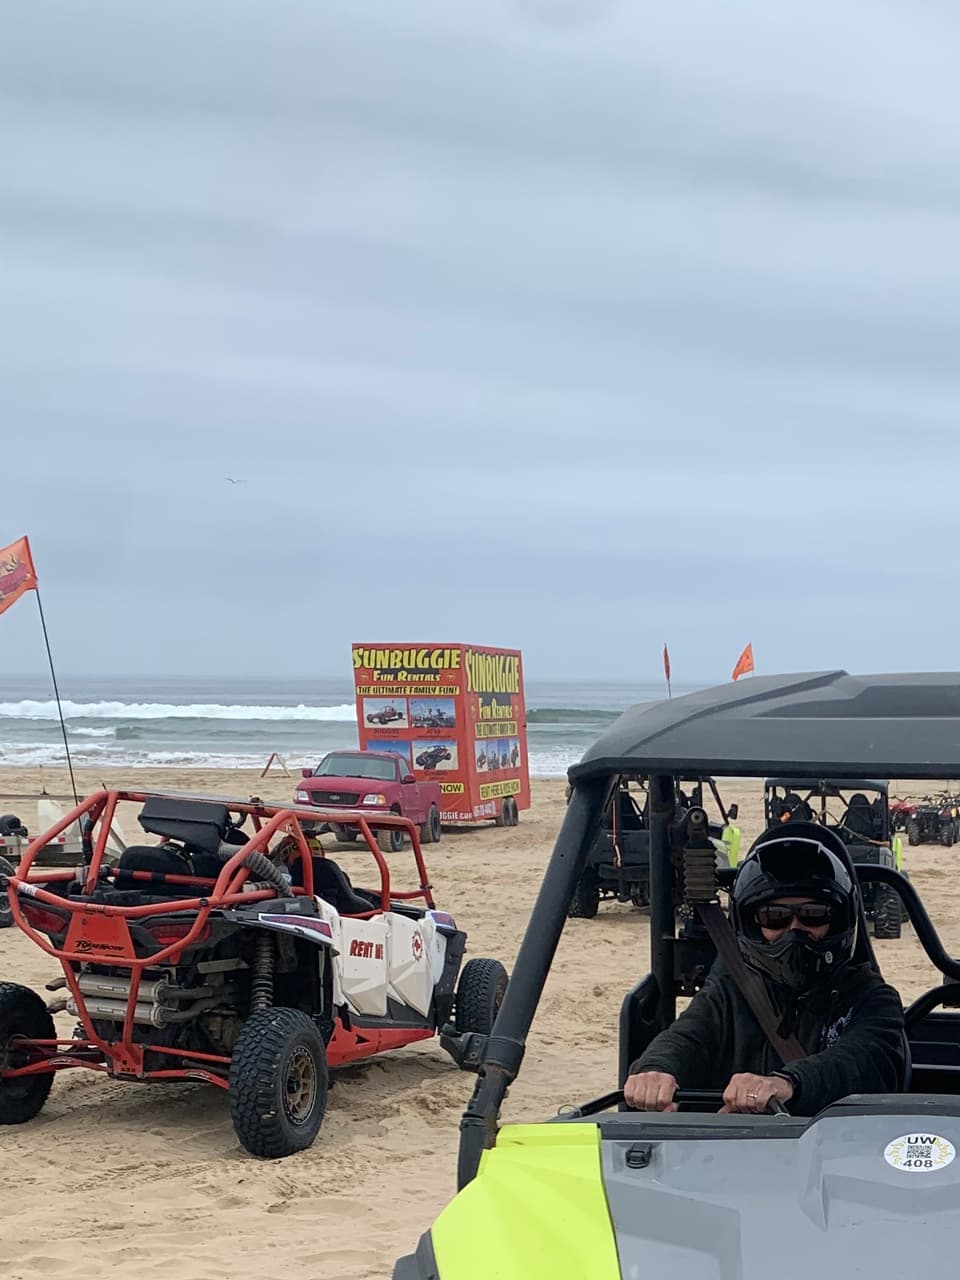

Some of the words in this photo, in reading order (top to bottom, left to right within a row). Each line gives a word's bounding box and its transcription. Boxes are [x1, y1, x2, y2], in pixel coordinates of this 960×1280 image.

[352, 648, 461, 669] SUNBUGGIE
[465, 649, 520, 693] SUNBUGGIE
[440, 784, 462, 793] NOW
[350, 939, 373, 959] RENT
[907, 1136, 937, 1145] UW
[903, 1159, 933, 1168] 408
